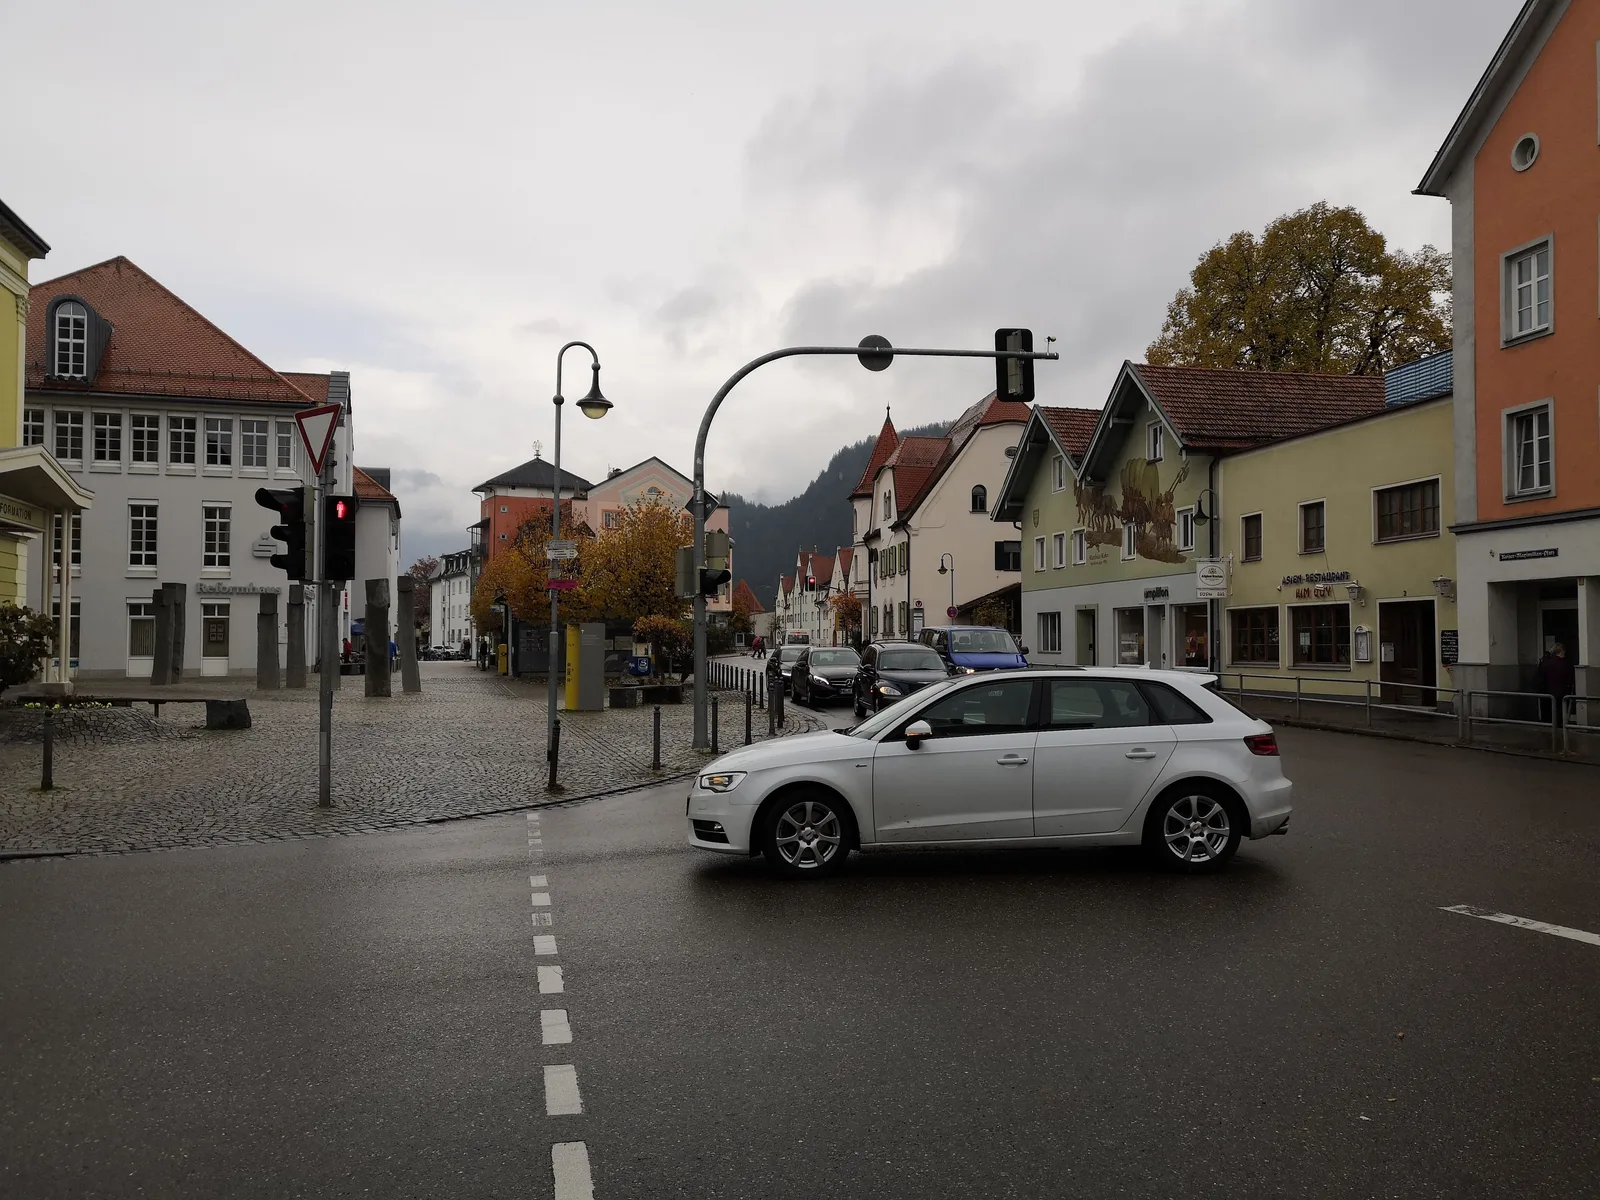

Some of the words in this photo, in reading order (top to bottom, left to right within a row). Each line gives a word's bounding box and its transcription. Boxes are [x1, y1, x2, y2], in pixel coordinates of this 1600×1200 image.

[1282, 571, 1350, 585] ASIEN-RESTAURANT
[196, 582, 282, 595] Reformhaus
[1144, 586, 1169, 601] amplifon
